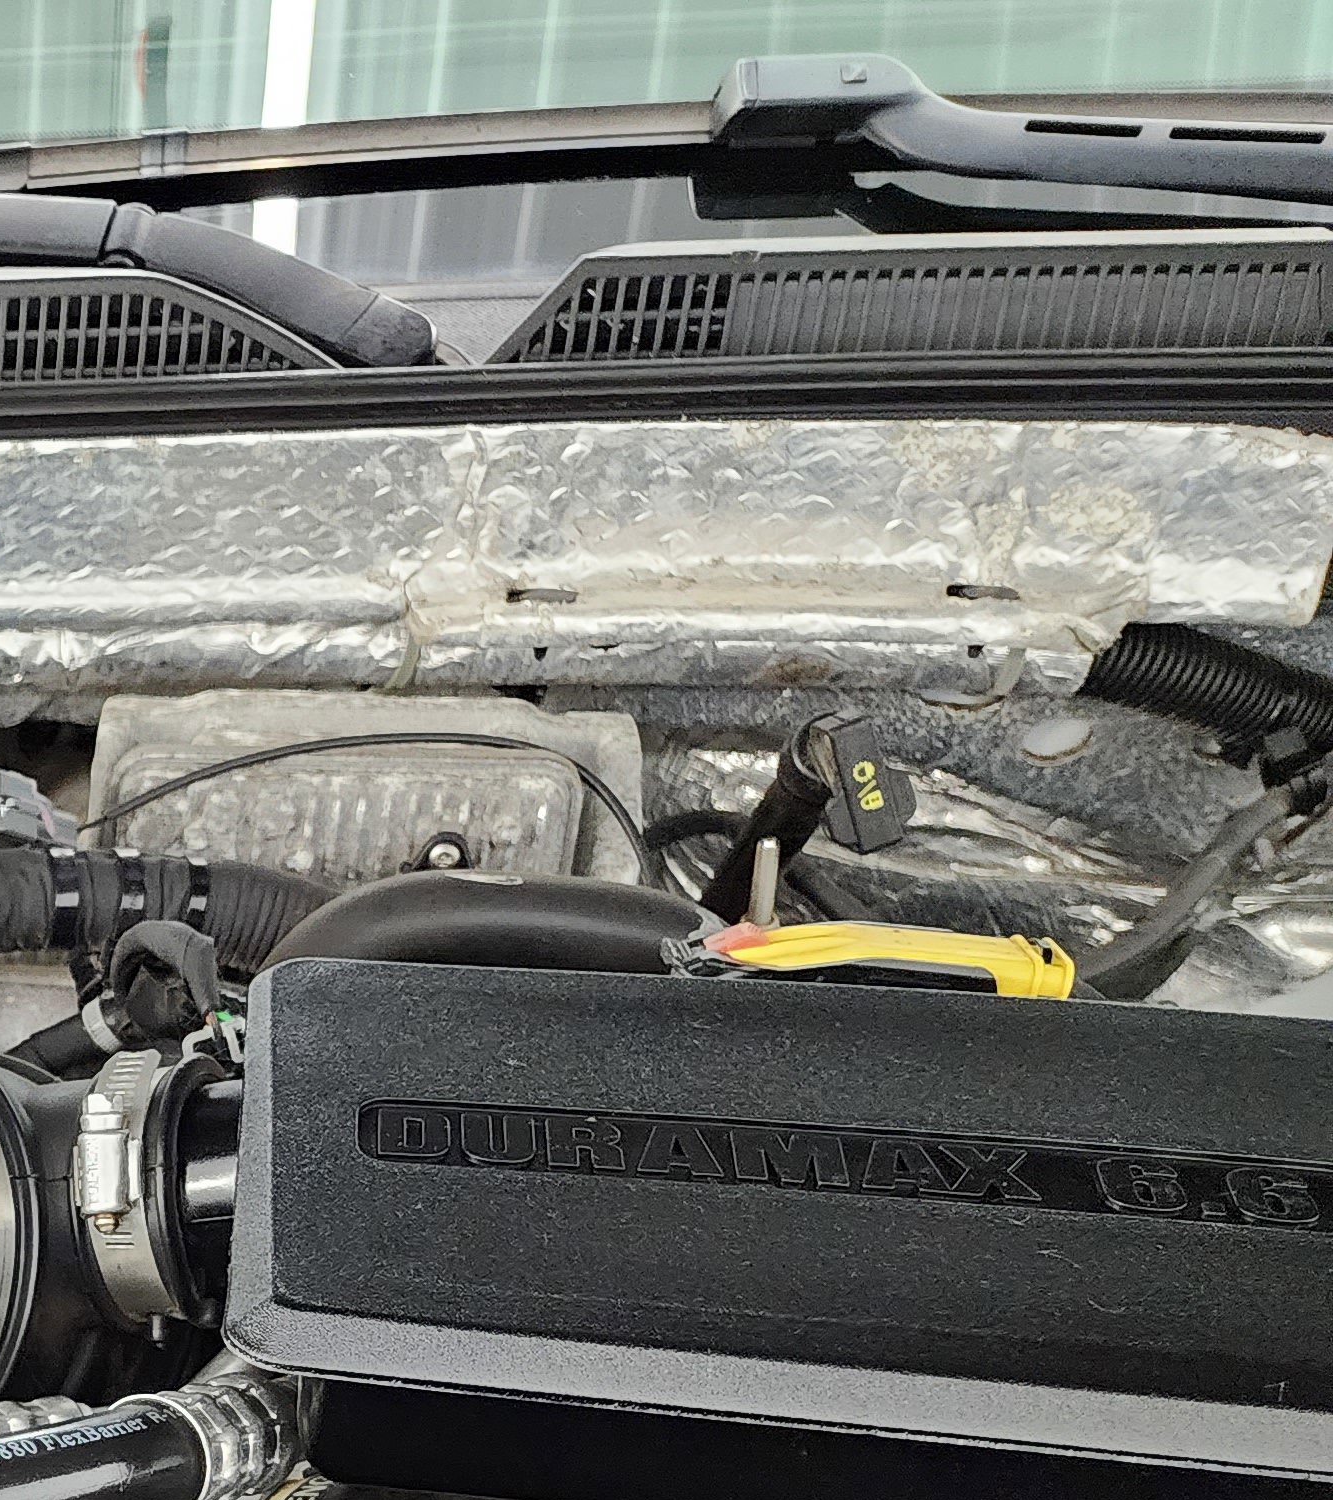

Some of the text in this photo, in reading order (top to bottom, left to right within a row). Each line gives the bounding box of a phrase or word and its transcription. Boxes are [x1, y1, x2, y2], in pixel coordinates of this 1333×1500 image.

[374, 1108, 1323, 1226] DURAMAX 6.6
[37, 1416, 148, 1453] FlexBarrier
